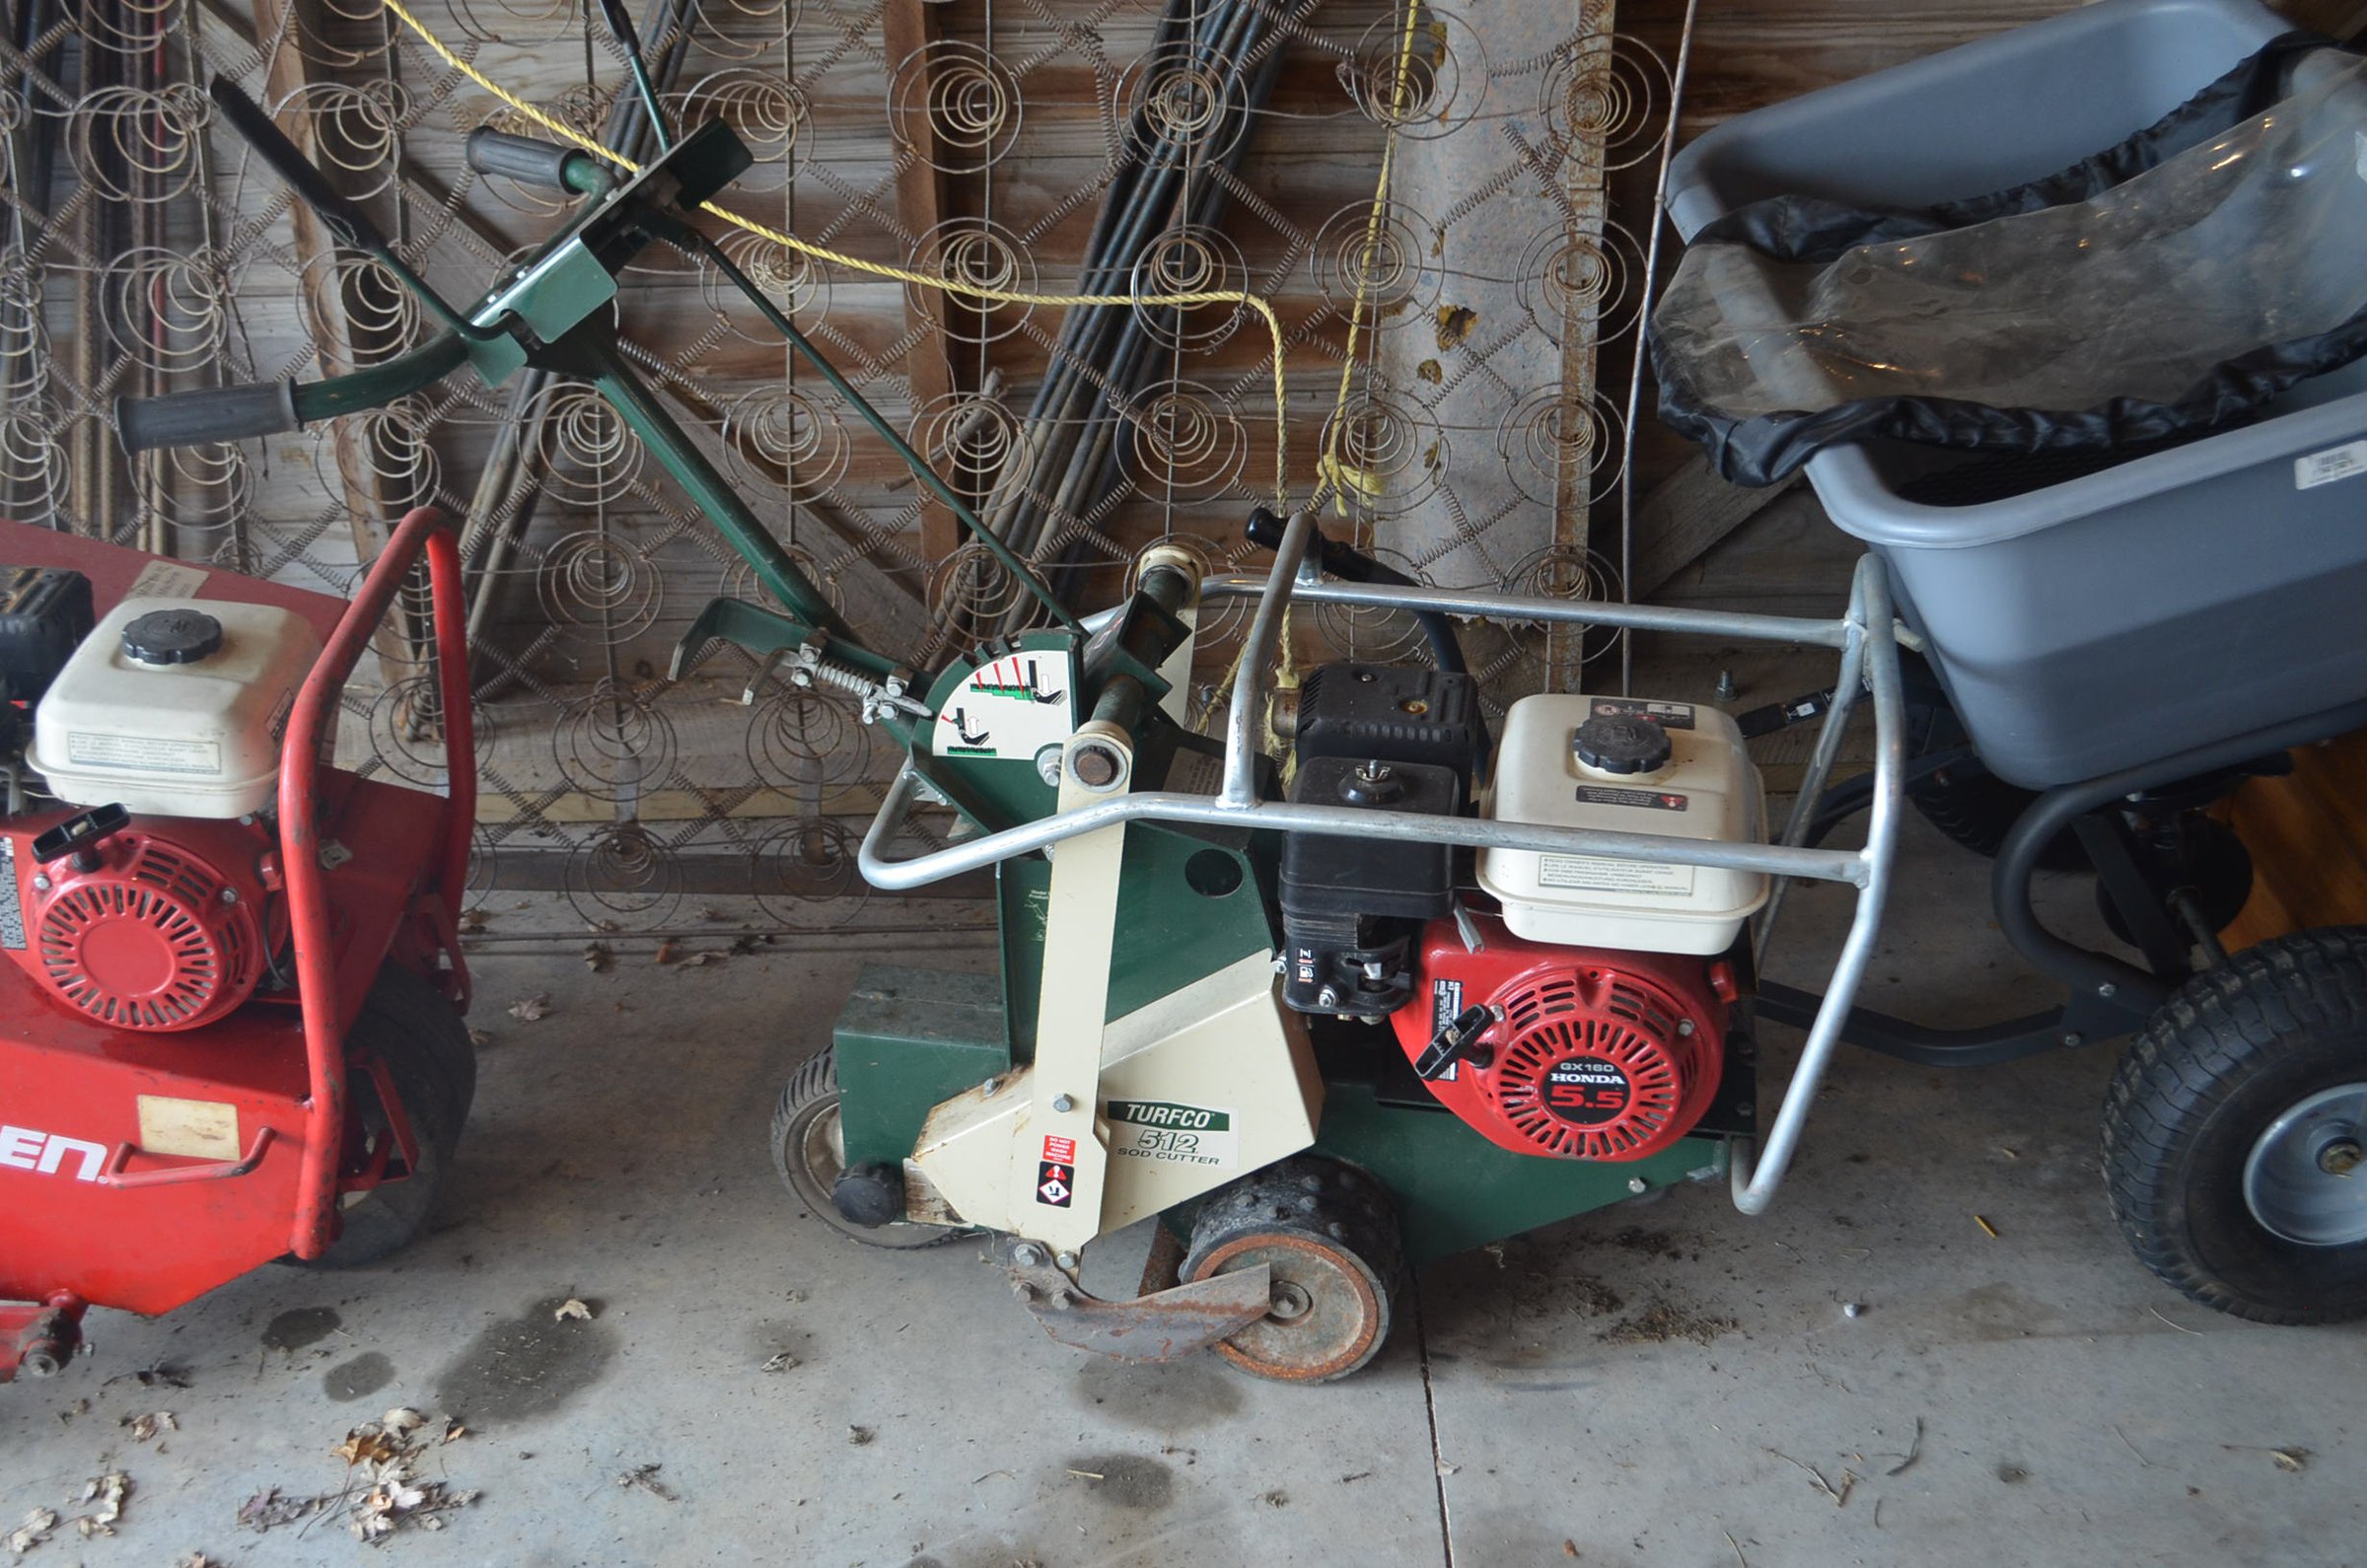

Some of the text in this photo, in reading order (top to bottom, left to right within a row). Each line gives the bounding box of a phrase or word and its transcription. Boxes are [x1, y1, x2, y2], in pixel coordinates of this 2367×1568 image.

[1560, 1062, 1614, 1072] GX160
[1550, 1073, 1625, 1084] HONDA
[1550, 1085, 1624, 1108] 5.5
[1126, 1104, 1211, 1128] TURFCO
[1138, 1129, 1199, 1153] 512
[1117, 1147, 1220, 1166] SOD CUTTER
